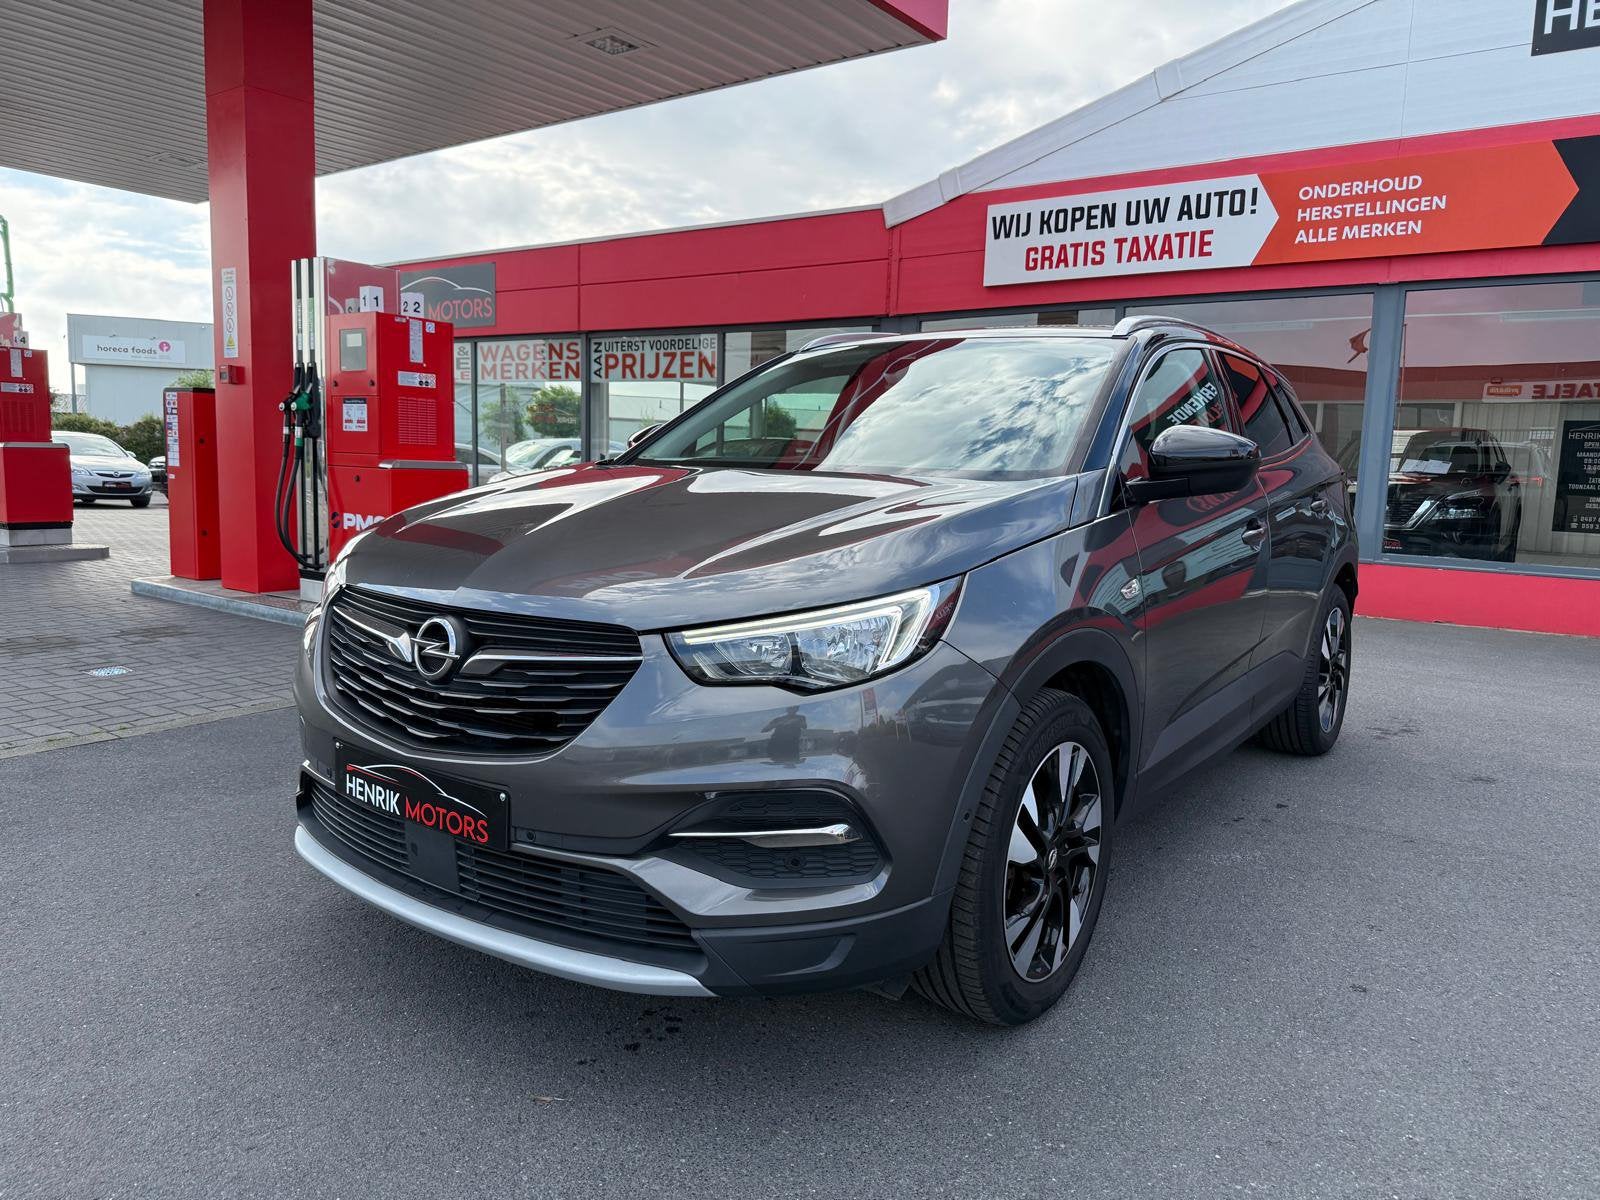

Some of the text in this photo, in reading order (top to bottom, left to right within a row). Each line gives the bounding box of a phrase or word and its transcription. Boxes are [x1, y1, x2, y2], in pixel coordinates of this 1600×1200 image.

[1299, 175, 1422, 200] ONDERHOUD
[992, 188, 1258, 240] WIJ KOPEN UW AUTO!
[1297, 195, 1447, 222] HERSTELLINGEN
[1295, 220, 1422, 244] ALLE MERKEN
[1025, 229, 1214, 271] GRATIS TAXATIE
[373, 296, 379, 307] 1
[413, 301, 421, 313] 2
[428, 297, 493, 320] MOTORS
[97, 345, 157, 355] horeca foods
[480, 342, 580, 362] WAGENS
[604, 337, 717, 352] UITERST VOORDELIGE
[481, 361, 580, 380] MERKEN
[604, 351, 717, 379] PRIJZEN
[343, 513, 386, 531] PM
[346, 774, 489, 843] HENRIK MOTORS
